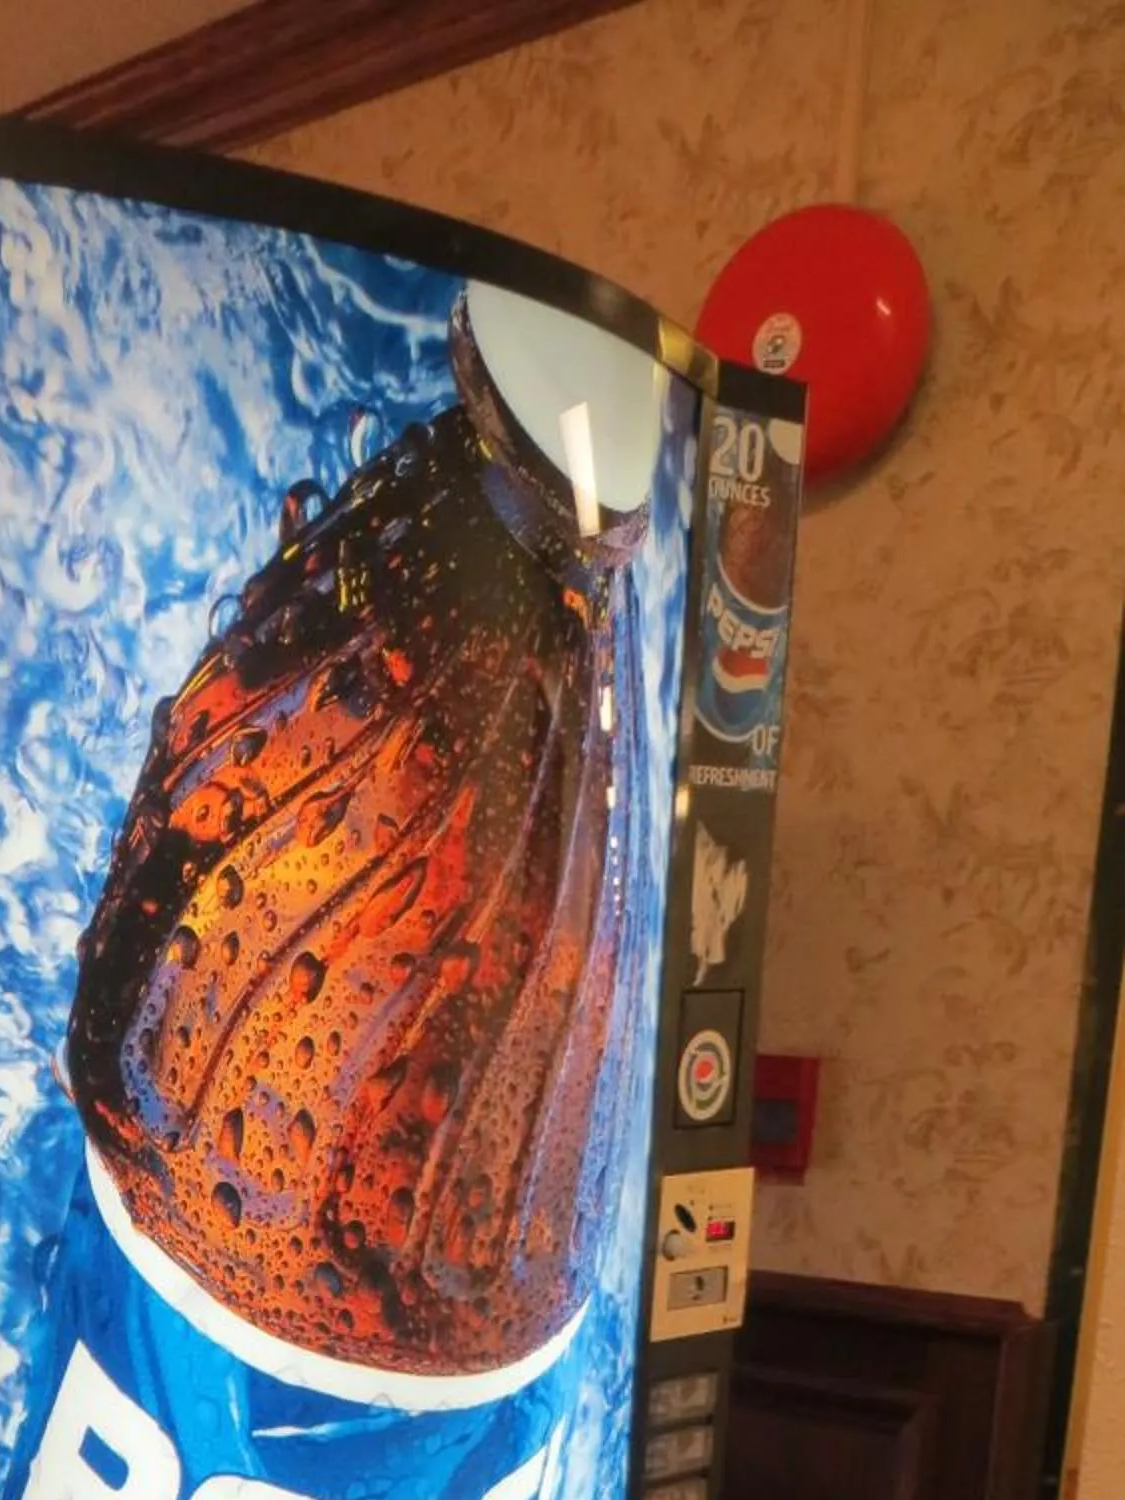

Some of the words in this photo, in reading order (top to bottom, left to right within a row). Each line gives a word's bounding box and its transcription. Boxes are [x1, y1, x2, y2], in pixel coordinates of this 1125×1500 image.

[709, 415, 765, 482] 20
[708, 476, 771, 508] OUNCES
[752, 724, 780, 756] OF
